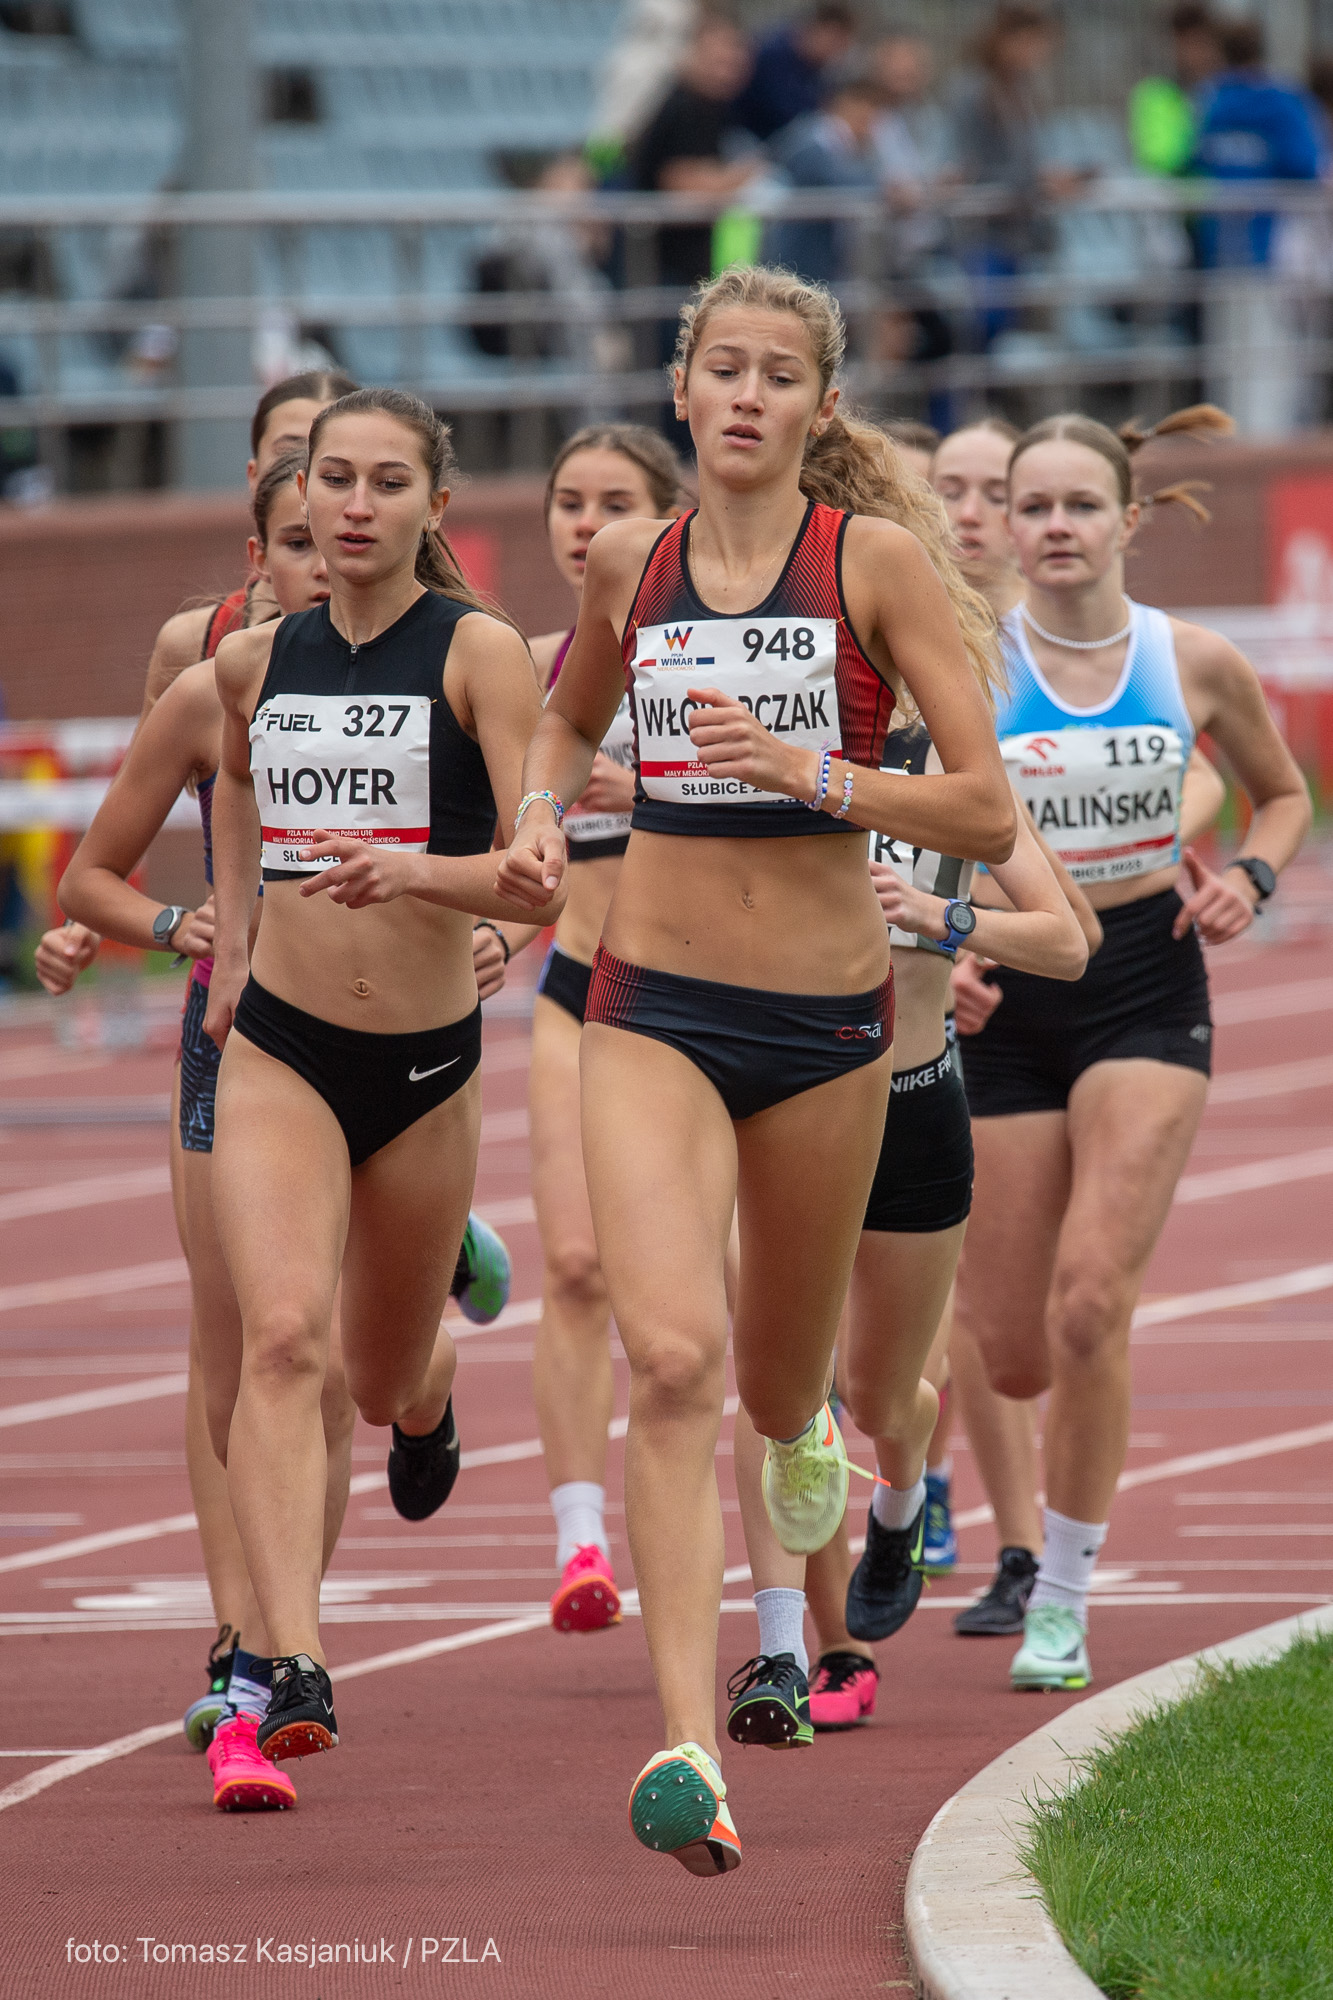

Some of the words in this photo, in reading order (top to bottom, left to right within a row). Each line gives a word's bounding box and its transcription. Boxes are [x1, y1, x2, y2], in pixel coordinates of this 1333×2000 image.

[743, 627, 816, 662] 948
[661, 657, 693, 666] WIMAR
[342, 705, 411, 737] 327
[641, 690, 830, 736] WŁOCZAK
[1104, 735, 1166, 767] 119
[267, 767, 398, 805] HOYER
[682, 782, 748, 795] SŁUBICE
[1026, 786, 1174, 831] ALIŃSKA
[341, 829, 360, 837] Polski
[891, 1067, 936, 1093] NIKE
